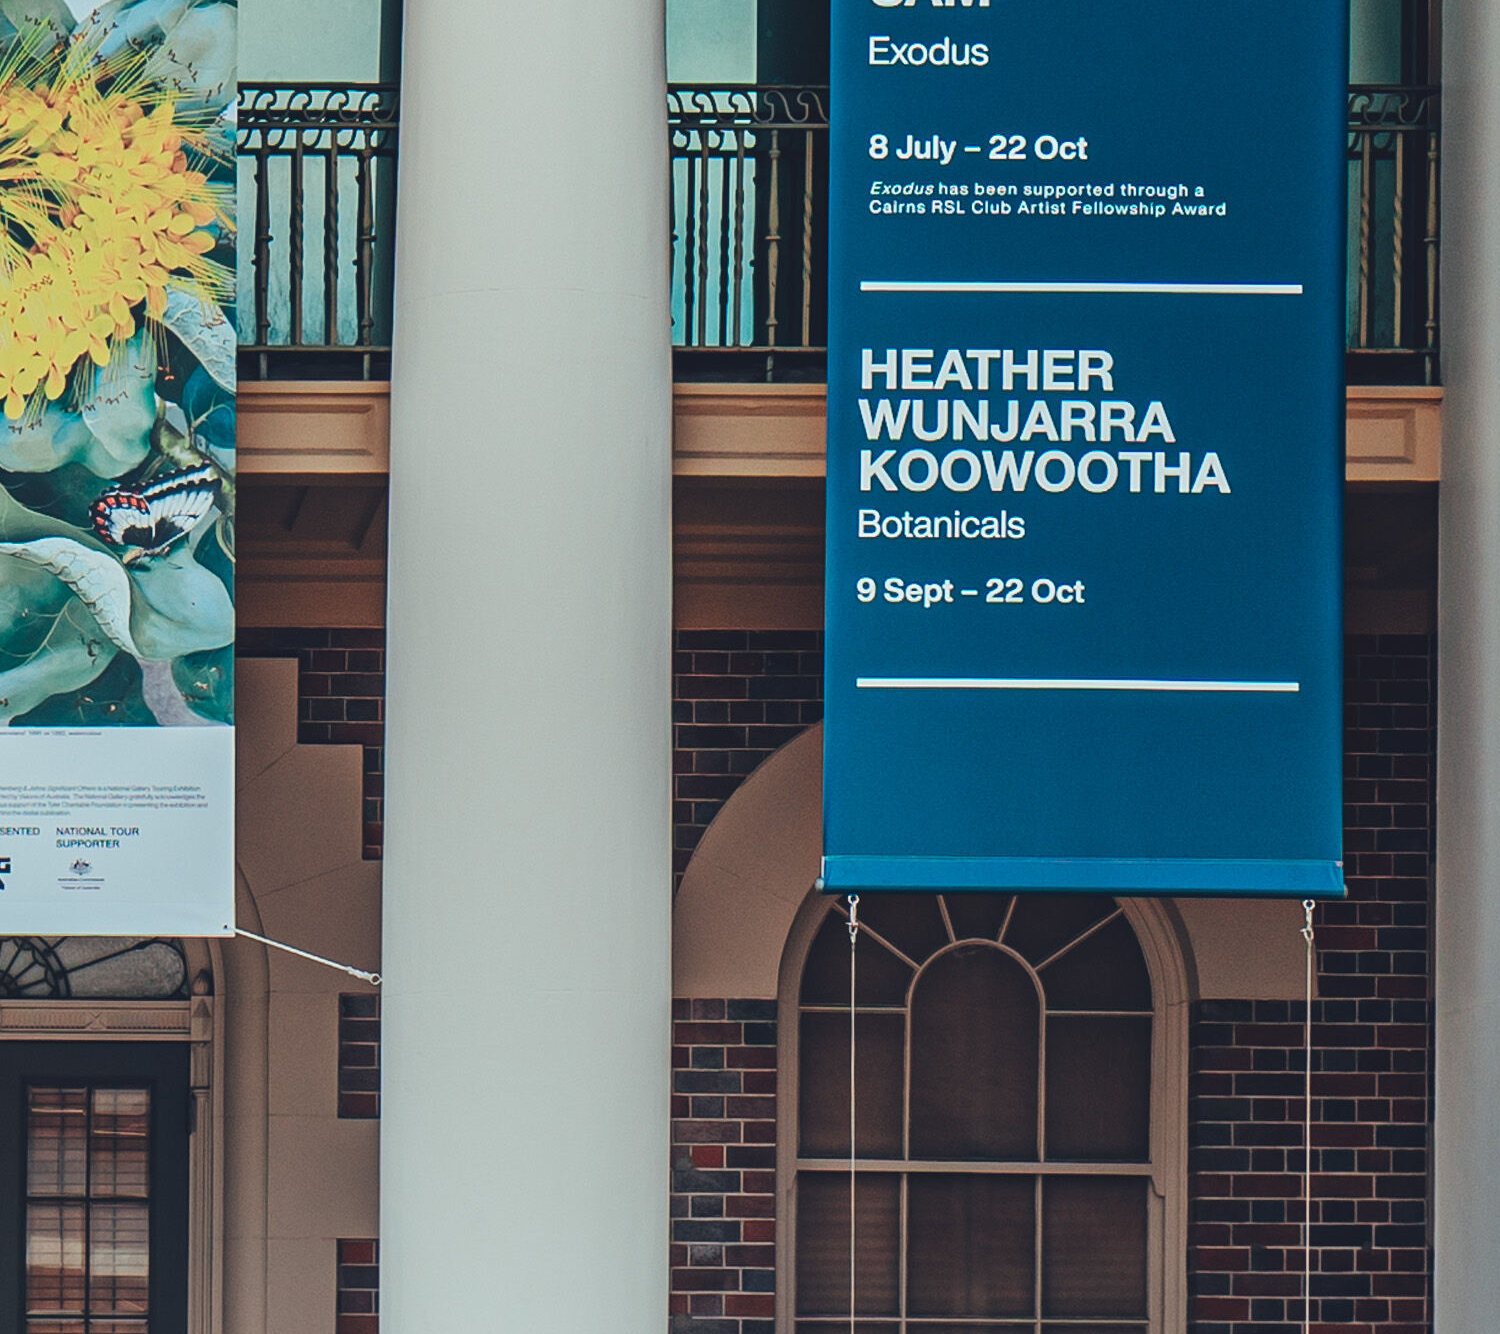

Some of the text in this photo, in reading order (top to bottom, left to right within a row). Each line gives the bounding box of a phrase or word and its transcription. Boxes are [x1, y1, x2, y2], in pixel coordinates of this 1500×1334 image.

[869, 36, 988, 66] Exodus
[869, 134, 888, 159] 8
[896, 135, 956, 165] July
[989, 135, 1026, 159] 22
[1035, 135, 1087, 159] Oct
[870, 182, 1204, 200] Exodus has been supported through a
[869, 200, 1226, 217] Cairns RSL Club Artist Fellowship Award
[862, 349, 1113, 391] HEATHER
[858, 399, 1176, 442] WUNJARRA
[861, 449, 1231, 493] KOOWOOTHA
[859, 509, 1025, 538] Botanicals
[857, 578, 876, 602] 9
[884, 578, 953, 608] Sept
[986, 578, 1023, 602] 22
[1032, 579, 1085, 603] Oct
[56, 827, 139, 836] NATIONAL TOUR
[56, 840, 120, 848] SUPPORTER
